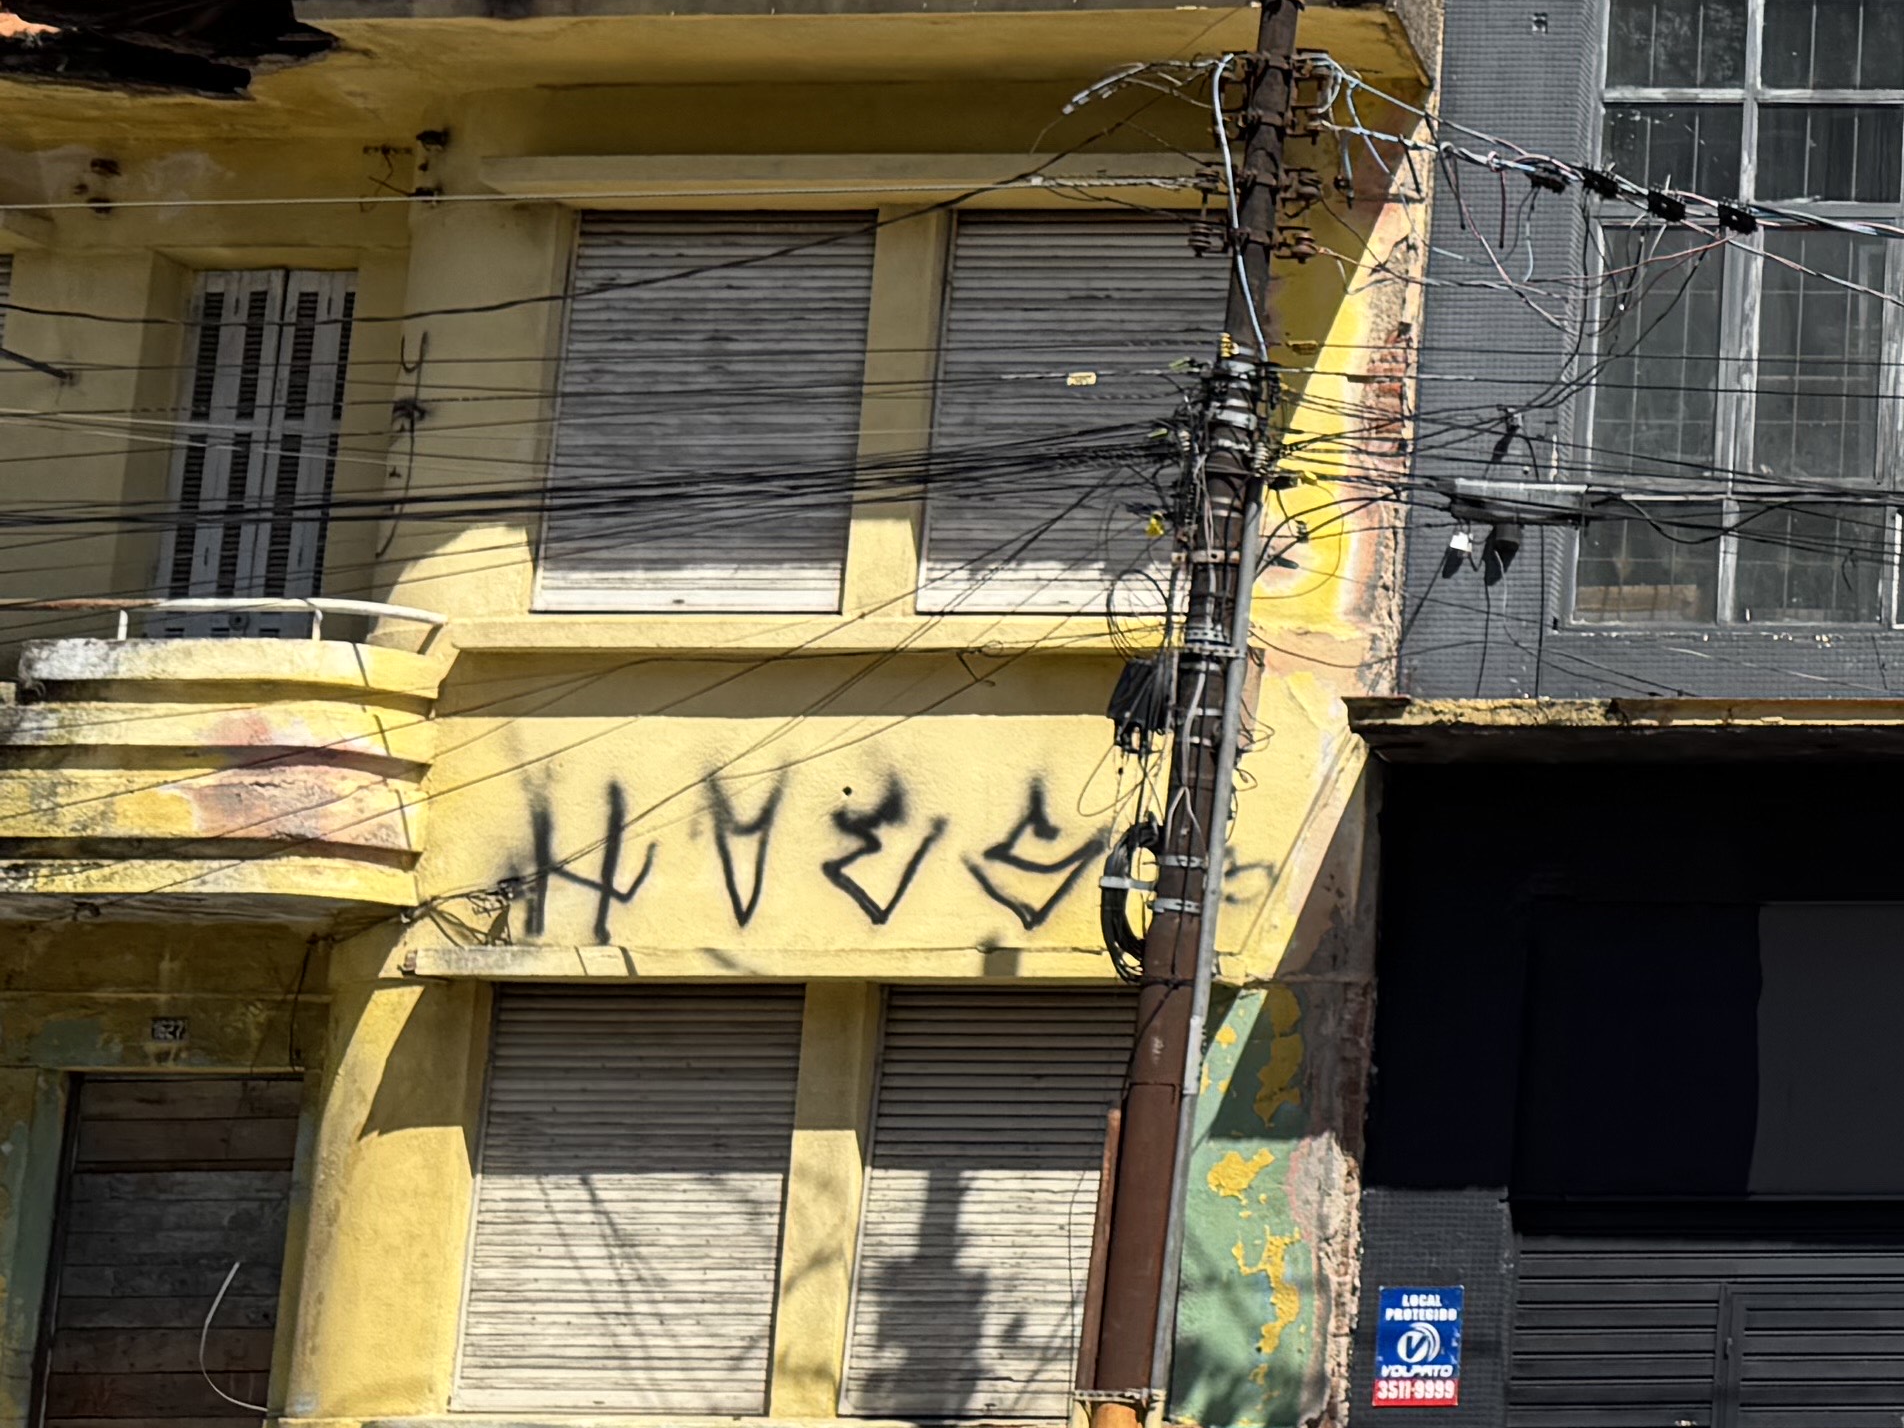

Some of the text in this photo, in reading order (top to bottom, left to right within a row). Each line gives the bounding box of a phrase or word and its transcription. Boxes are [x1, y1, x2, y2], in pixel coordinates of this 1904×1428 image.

[1402, 1294, 1442, 1307] LOCAL
[1385, 1308, 1458, 1321] PROTEGIDO
[1381, 1364, 1454, 1378] VOLPATO
[1377, 1380, 1456, 1400] 3511-9999
